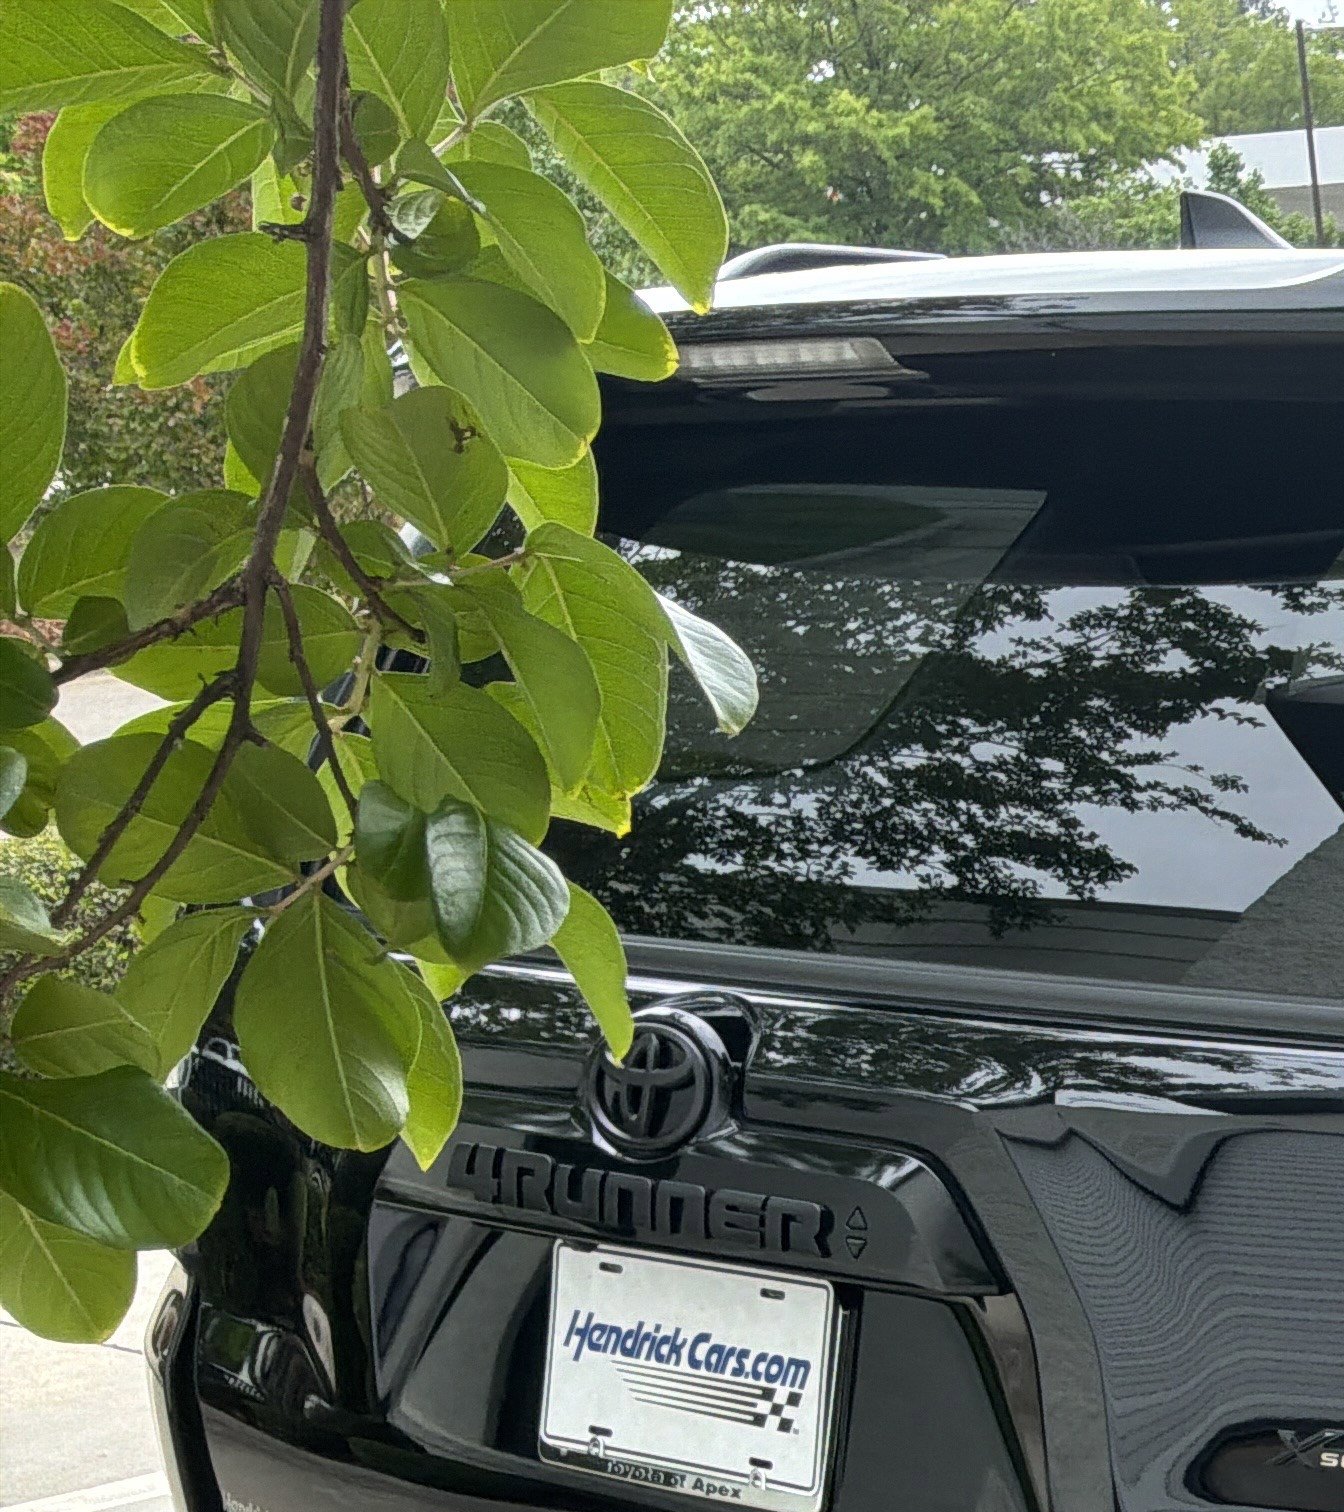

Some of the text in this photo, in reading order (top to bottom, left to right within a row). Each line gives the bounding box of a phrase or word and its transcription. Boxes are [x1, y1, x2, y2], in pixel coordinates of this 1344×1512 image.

[447, 1141, 836, 1258] 4RUNNER
[607, 1459, 742, 1499] Toyota of Apex
